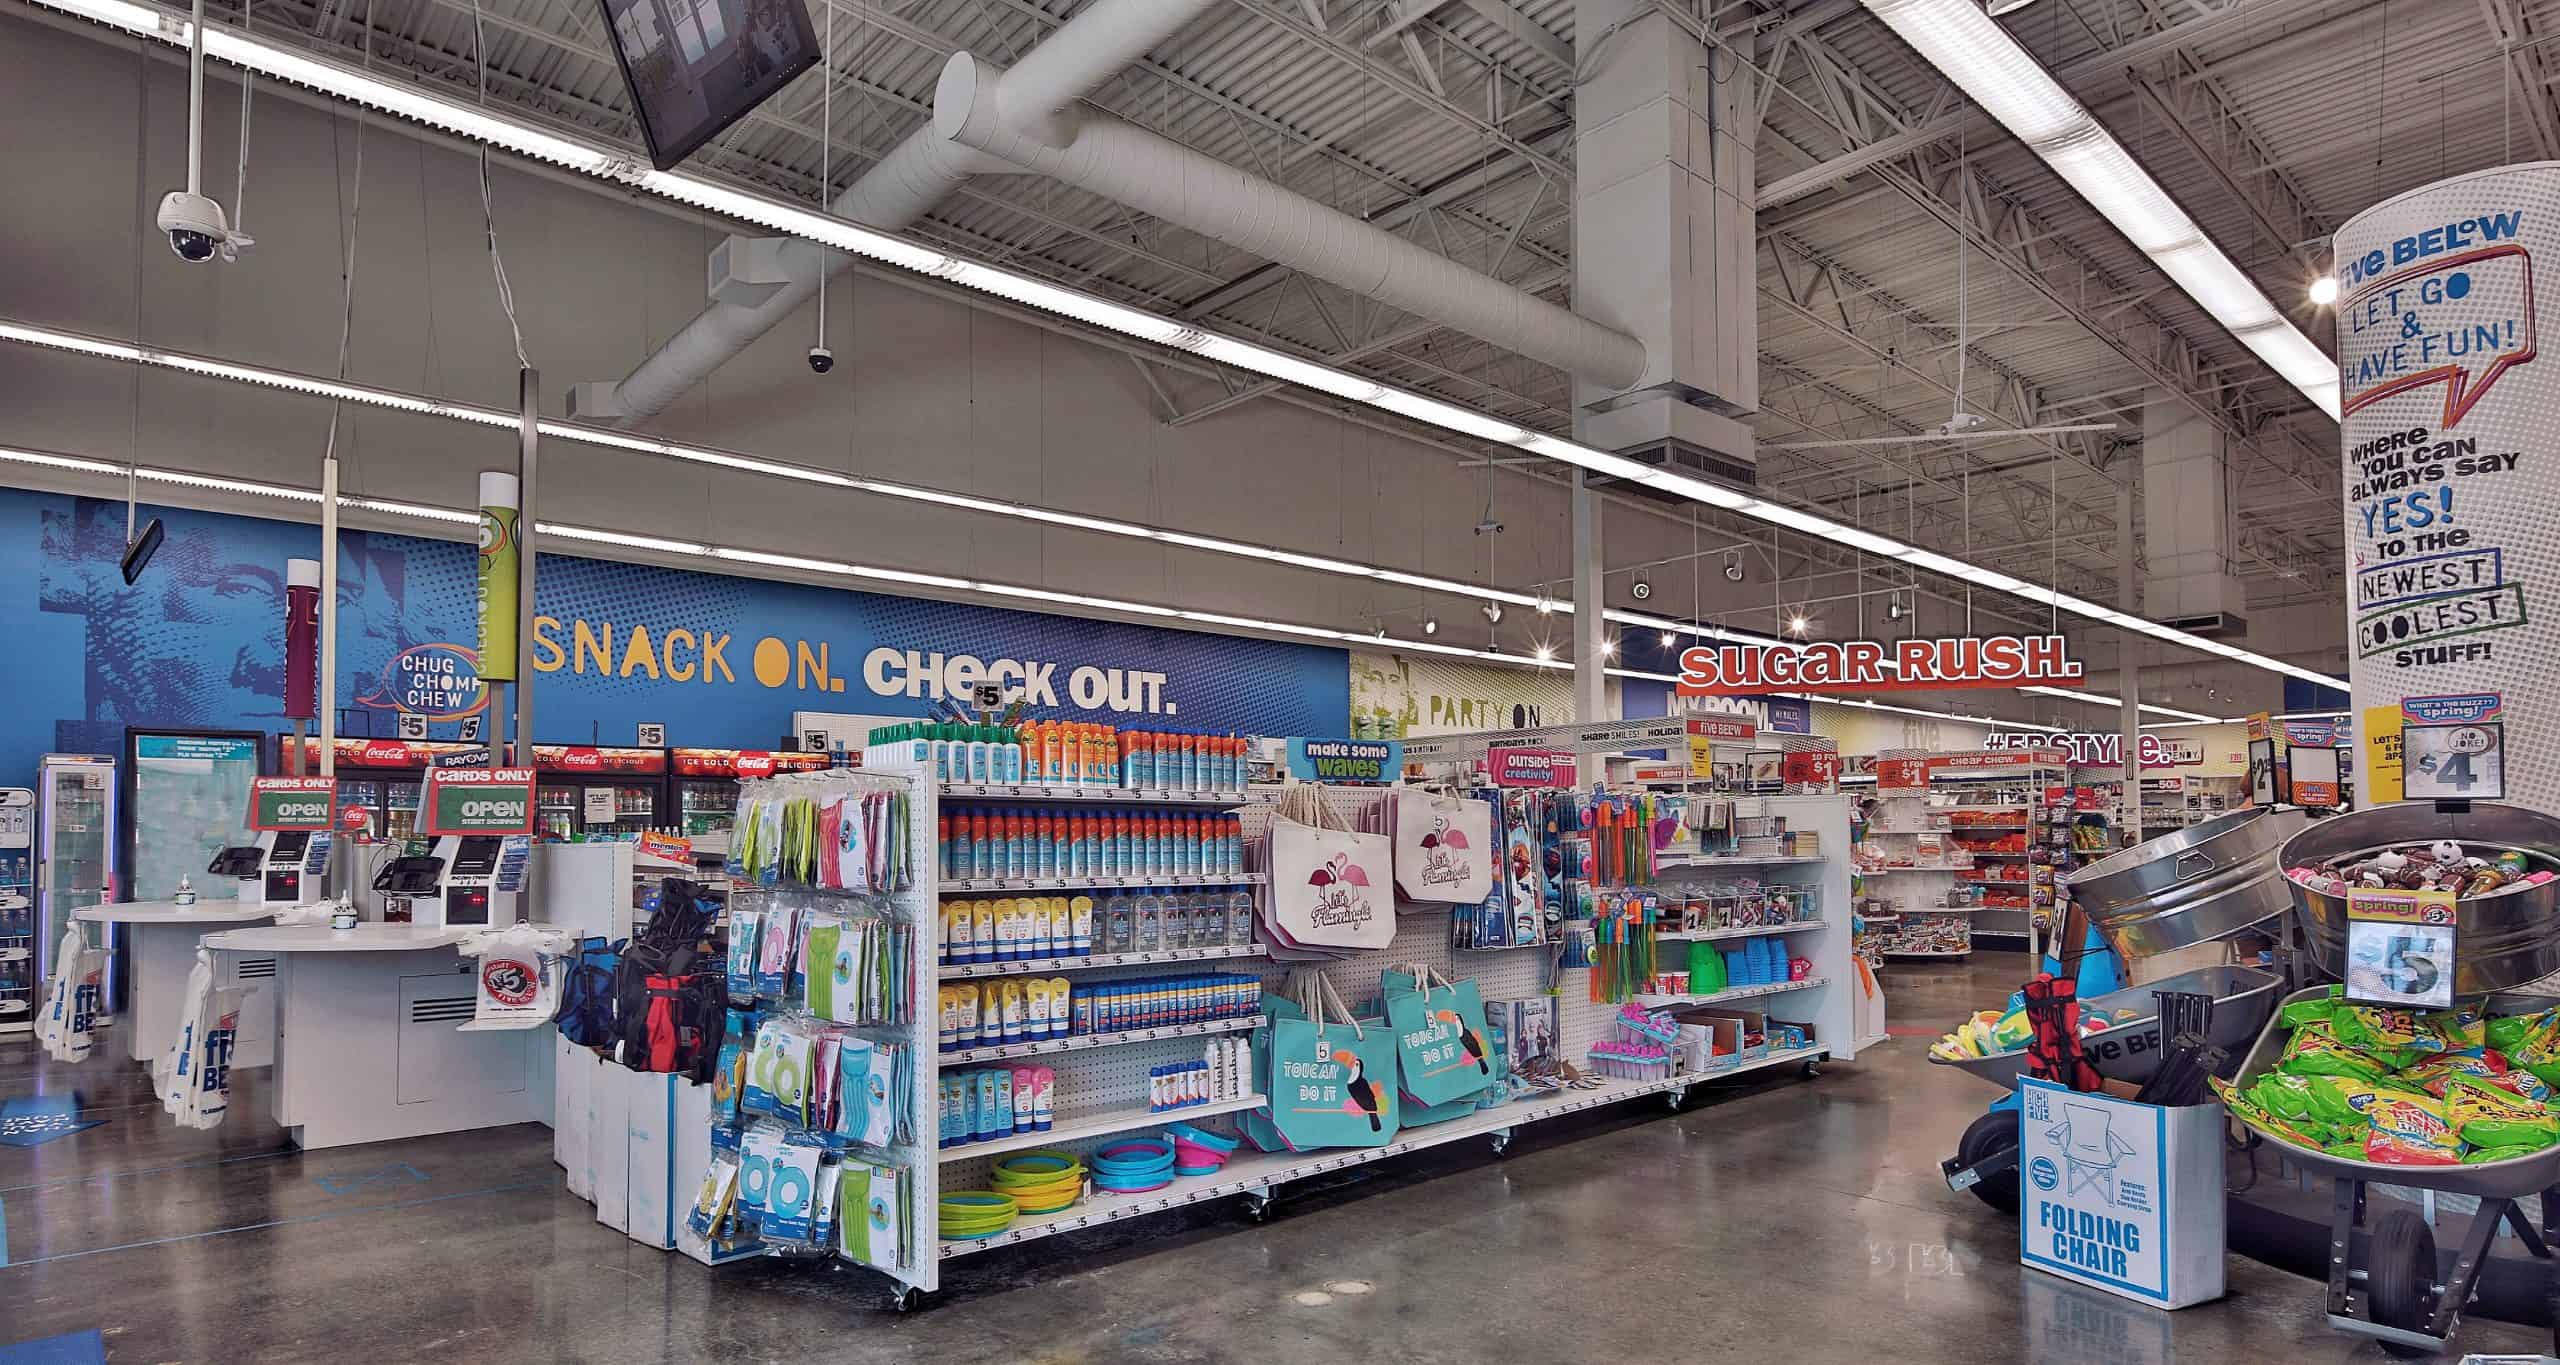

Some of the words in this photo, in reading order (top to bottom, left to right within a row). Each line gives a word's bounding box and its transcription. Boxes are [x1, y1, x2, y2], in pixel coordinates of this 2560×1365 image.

[2353, 288, 2403, 333] LET
[2421, 272, 2470, 305] GO
[2401, 311, 2423, 339] &
[2346, 343, 2408, 389] HAVE
[2422, 320, 2513, 363] FUN!
[2361, 486, 2454, 538] YES!
[2377, 540, 2405, 559] TO
[2363, 559, 2486, 600] NEWEST
[2361, 595, 2502, 649] COOLEST
[533, 616, 735, 683] SNACK
[753, 637, 845, 692] ON.
[402, 656, 455, 674] CHUG
[407, 691, 463, 707] CHEW
[976, 686, 999, 706] $5
[1430, 695, 1503, 729] PARTY
[1512, 703, 1541, 729] ON
[2424, 706, 2478, 718] spring!
[400, 716, 423, 737] $5
[463, 720, 477, 738] $5
[640, 727, 661, 744] $5
[806, 733, 825, 750] $5
[2454, 739, 2484, 748] JOKE!
[2461, 732, 2476, 740] NO
[366, 747, 405, 760] Coca-Cola
[1308, 742, 1348, 756] make
[1351, 745, 1388, 758] some
[564, 752, 598, 766] Coca-Cola
[683, 759, 699, 767] ICE
[704, 759, 729, 767] COLD
[737, 757, 769, 769] Coca-Cola
[494, 770, 533, 781] ONLY
[1318, 759, 1380, 778] waves
[1505, 769, 1553, 782] creativity!
[1813, 763, 1834, 783] $1
[2419, 753, 2478, 792] $4
[304, 779, 336, 788] ONLY
[1902, 769, 1924, 786] $1
[2354, 900, 2414, 914] spring!
[1284, 1062, 1339, 1079] TOUCAN
[1300, 1086, 1320, 1101] DO
[1324, 1086, 1336, 1101] IT
[2040, 1200, 2140, 1253] FOLDING
[2053, 1232, 2127, 1278] CHAIR
